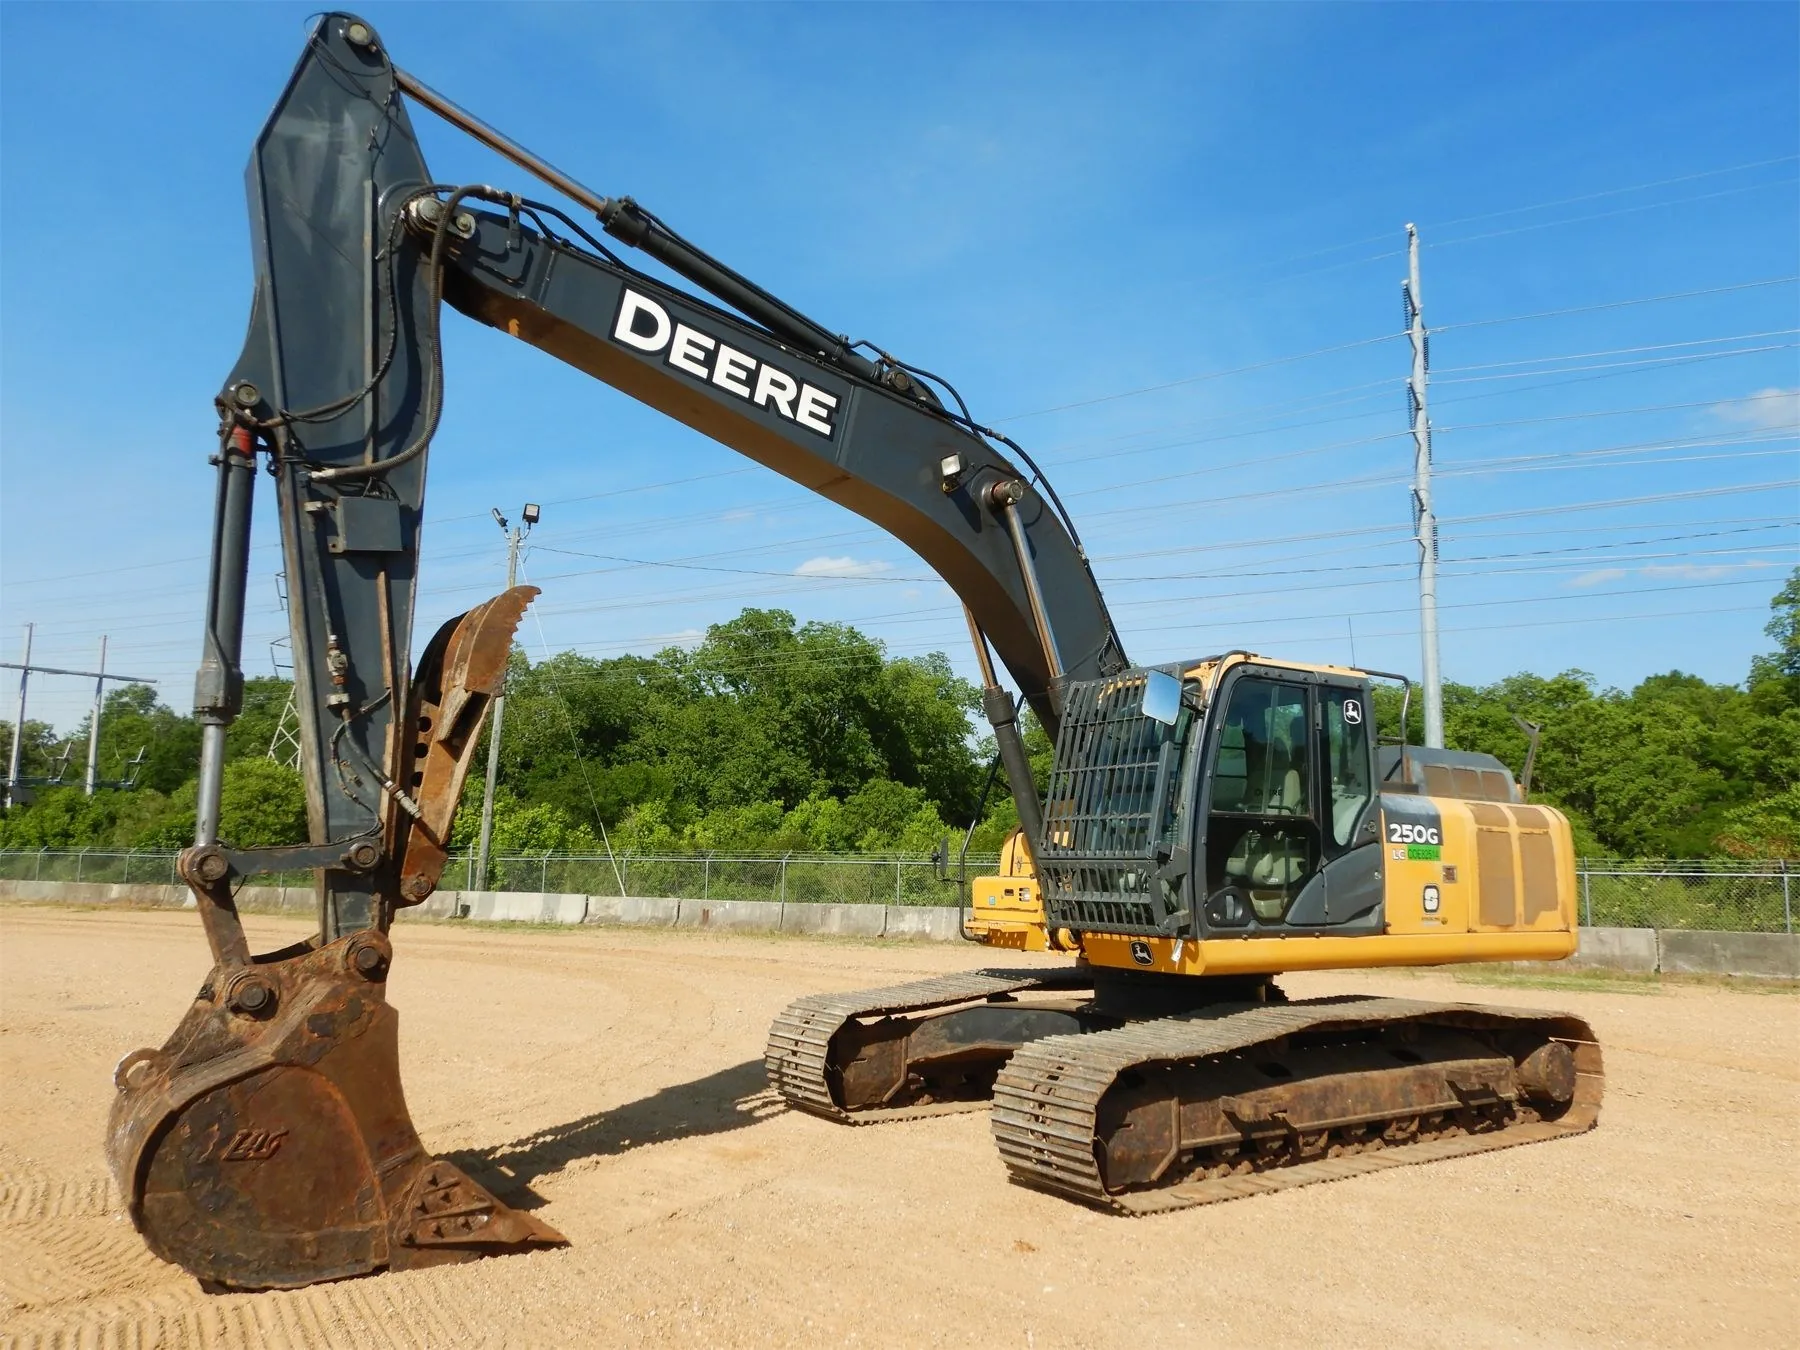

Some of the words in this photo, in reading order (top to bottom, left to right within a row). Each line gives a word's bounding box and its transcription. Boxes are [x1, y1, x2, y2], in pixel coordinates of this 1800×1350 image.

[614, 288, 838, 436] DEERE
[1389, 823, 1439, 845] 250G
[1392, 849, 1406, 860] LC
